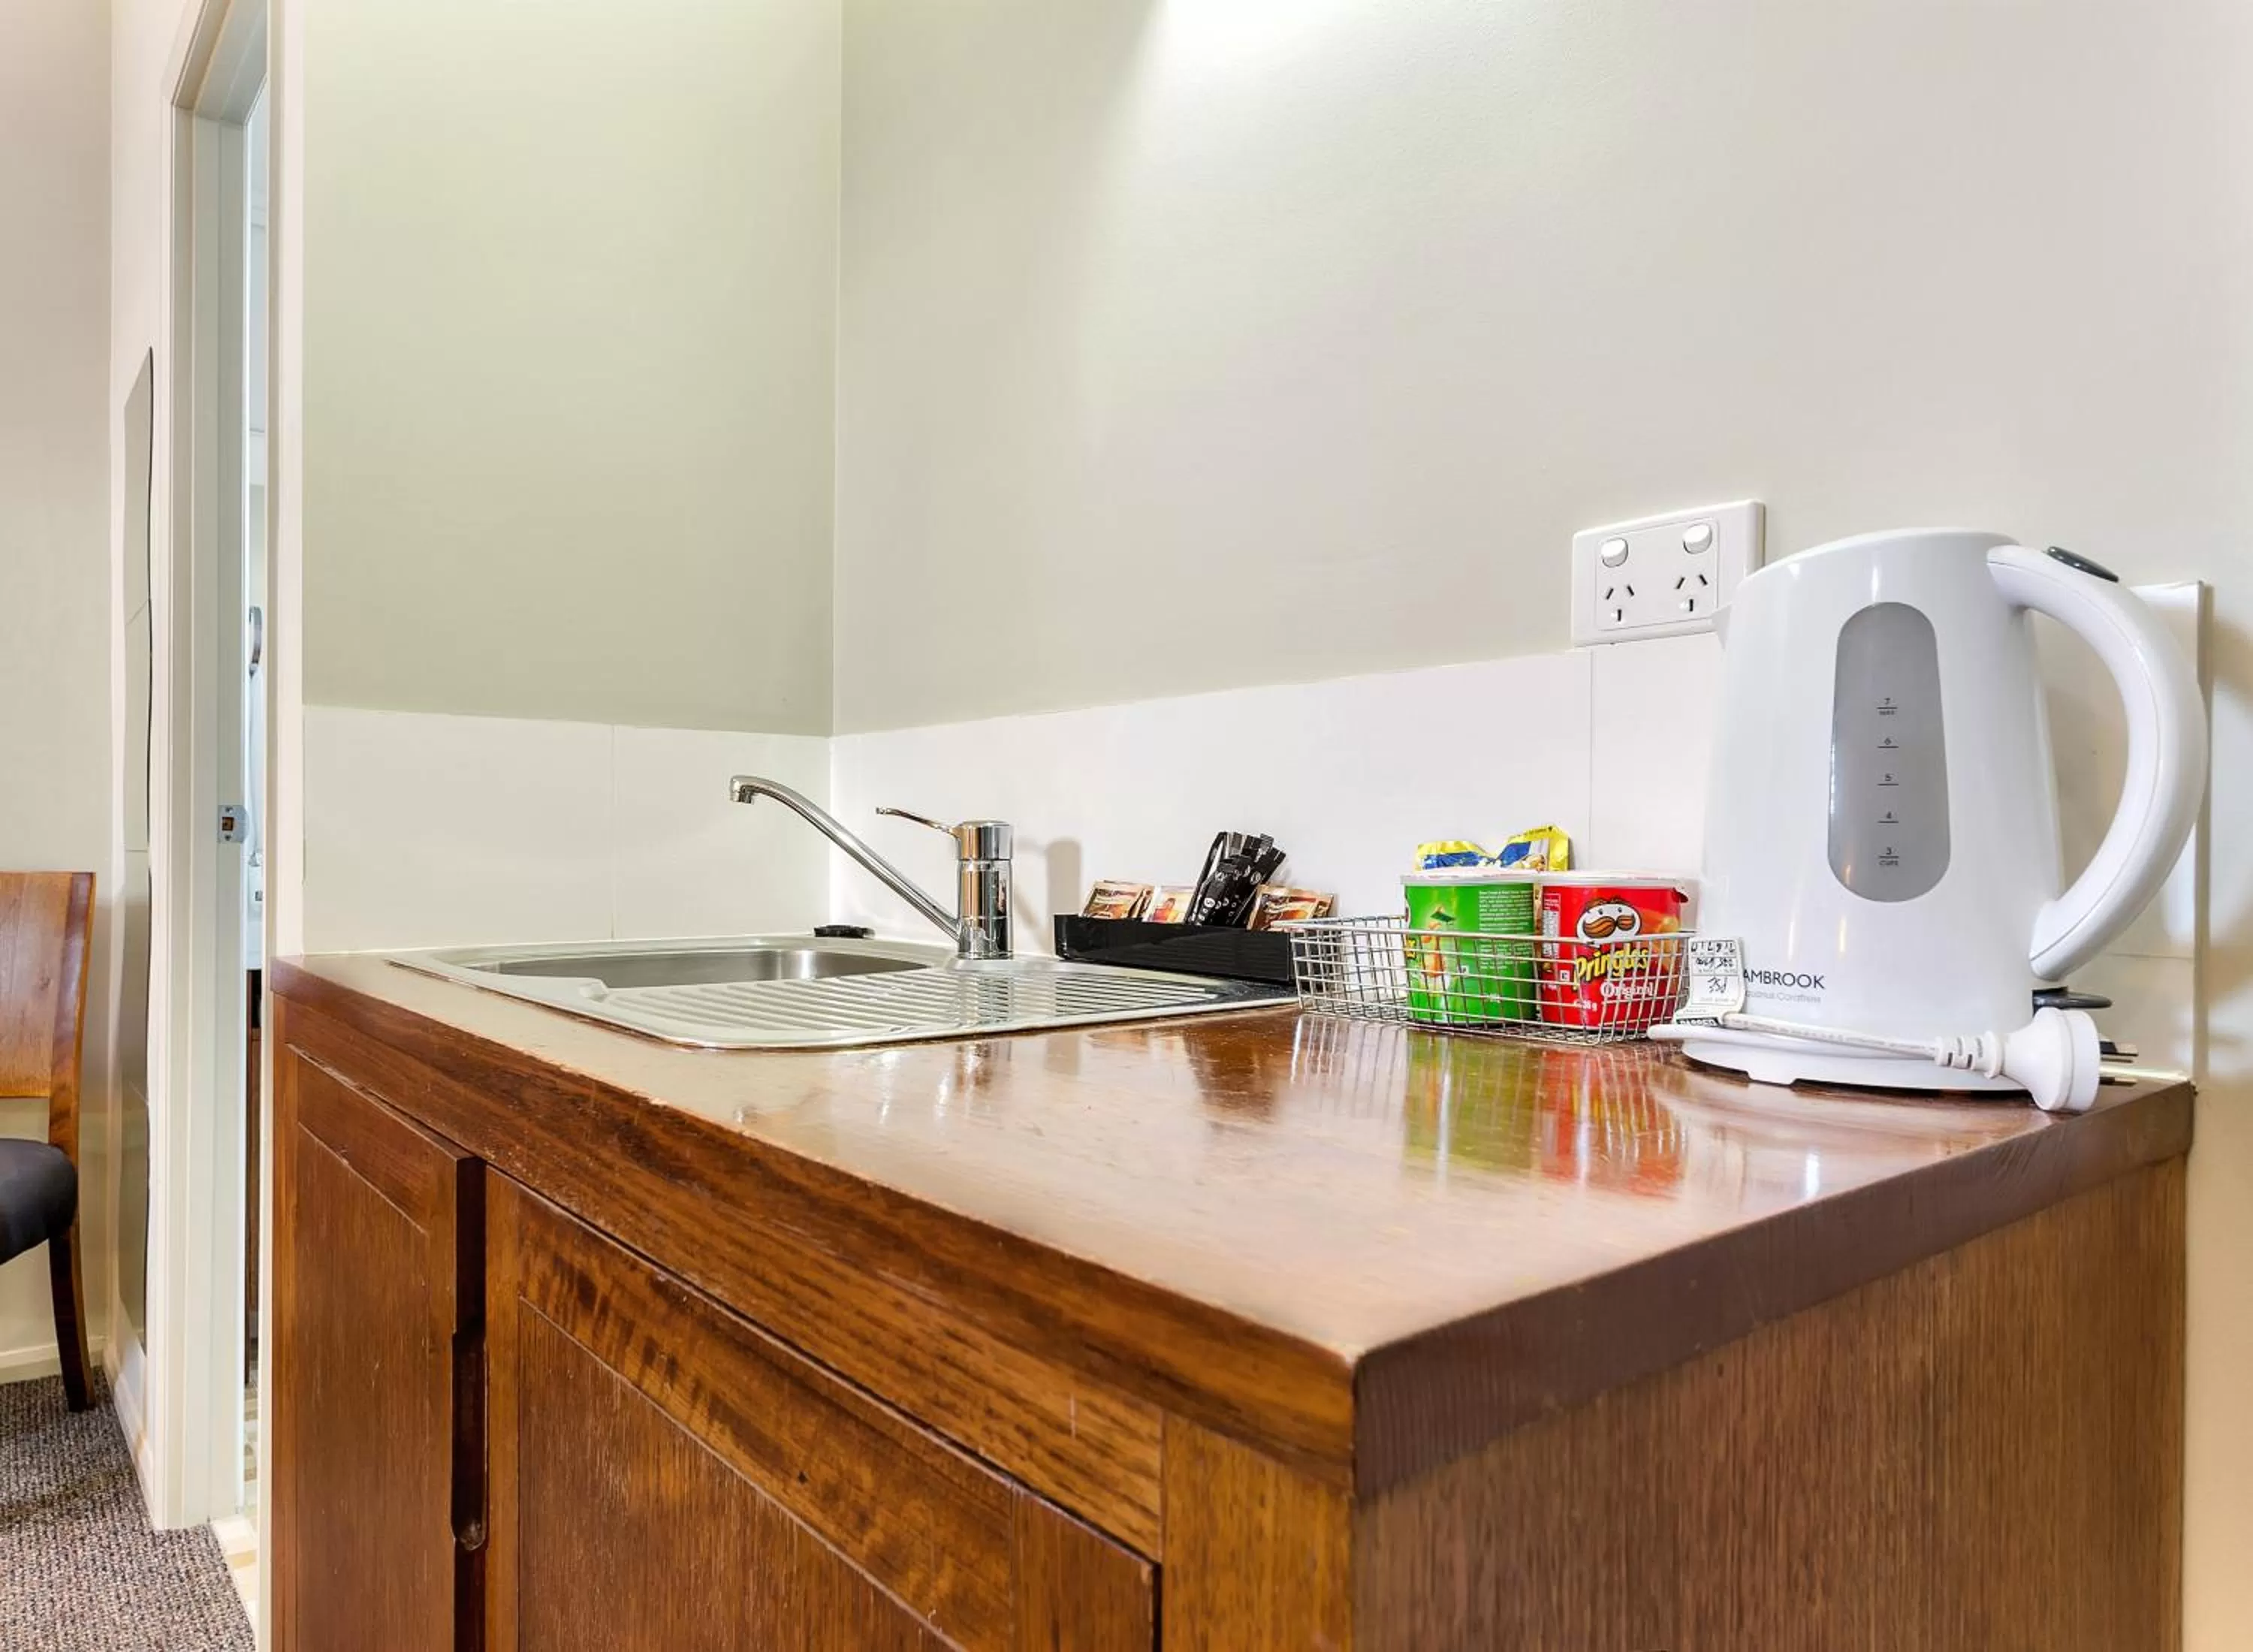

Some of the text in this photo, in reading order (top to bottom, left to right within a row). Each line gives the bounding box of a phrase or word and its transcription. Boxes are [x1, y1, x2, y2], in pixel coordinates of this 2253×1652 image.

[1884, 773, 1892, 782] 5
[1885, 811, 1892, 819] 4
[1886, 846, 1892, 855] 3
[1573, 943, 1649, 990] Pringles
[1743, 969, 1825, 989] AMBROOK
